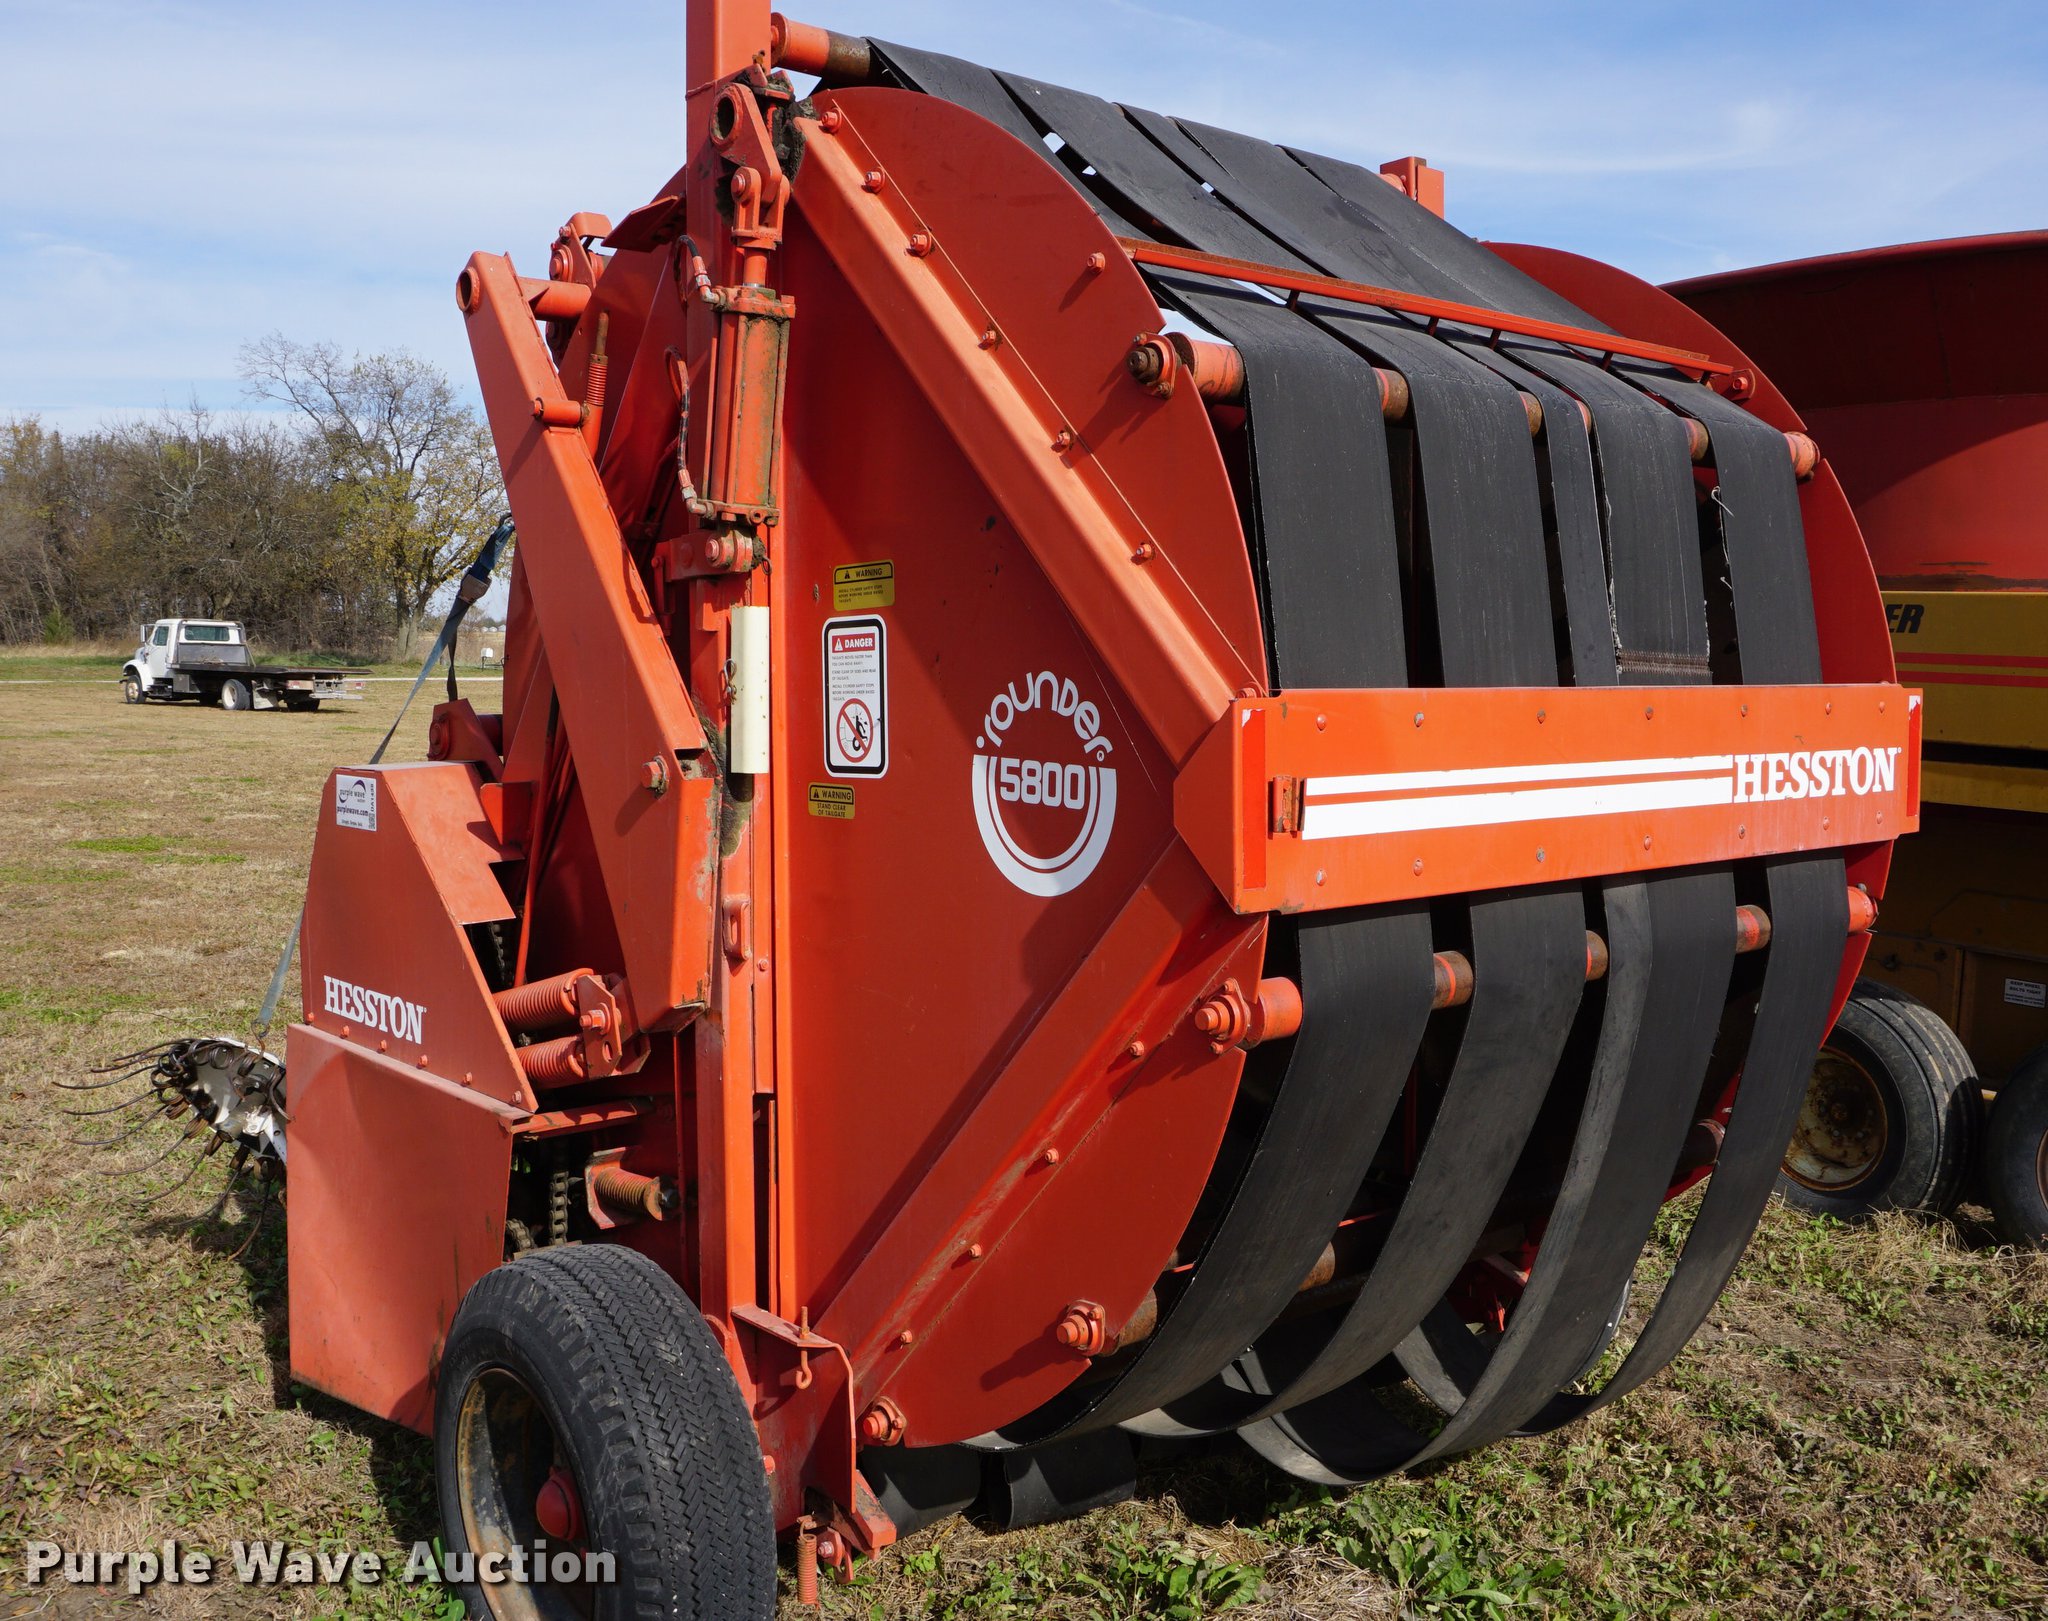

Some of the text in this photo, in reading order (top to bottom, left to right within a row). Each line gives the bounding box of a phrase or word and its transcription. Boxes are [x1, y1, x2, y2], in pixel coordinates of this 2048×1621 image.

[855, 568, 883, 578] WARNING
[844, 637, 873, 648] DANGER
[1733, 746, 1898, 803] HESSTON
[1000, 757, 1085, 810] 5800
[822, 790, 851, 801] WARNING
[817, 802, 831, 810] STAND
[825, 810, 846, 818] TAILGATE
[324, 975, 423, 1045] HESSTON
